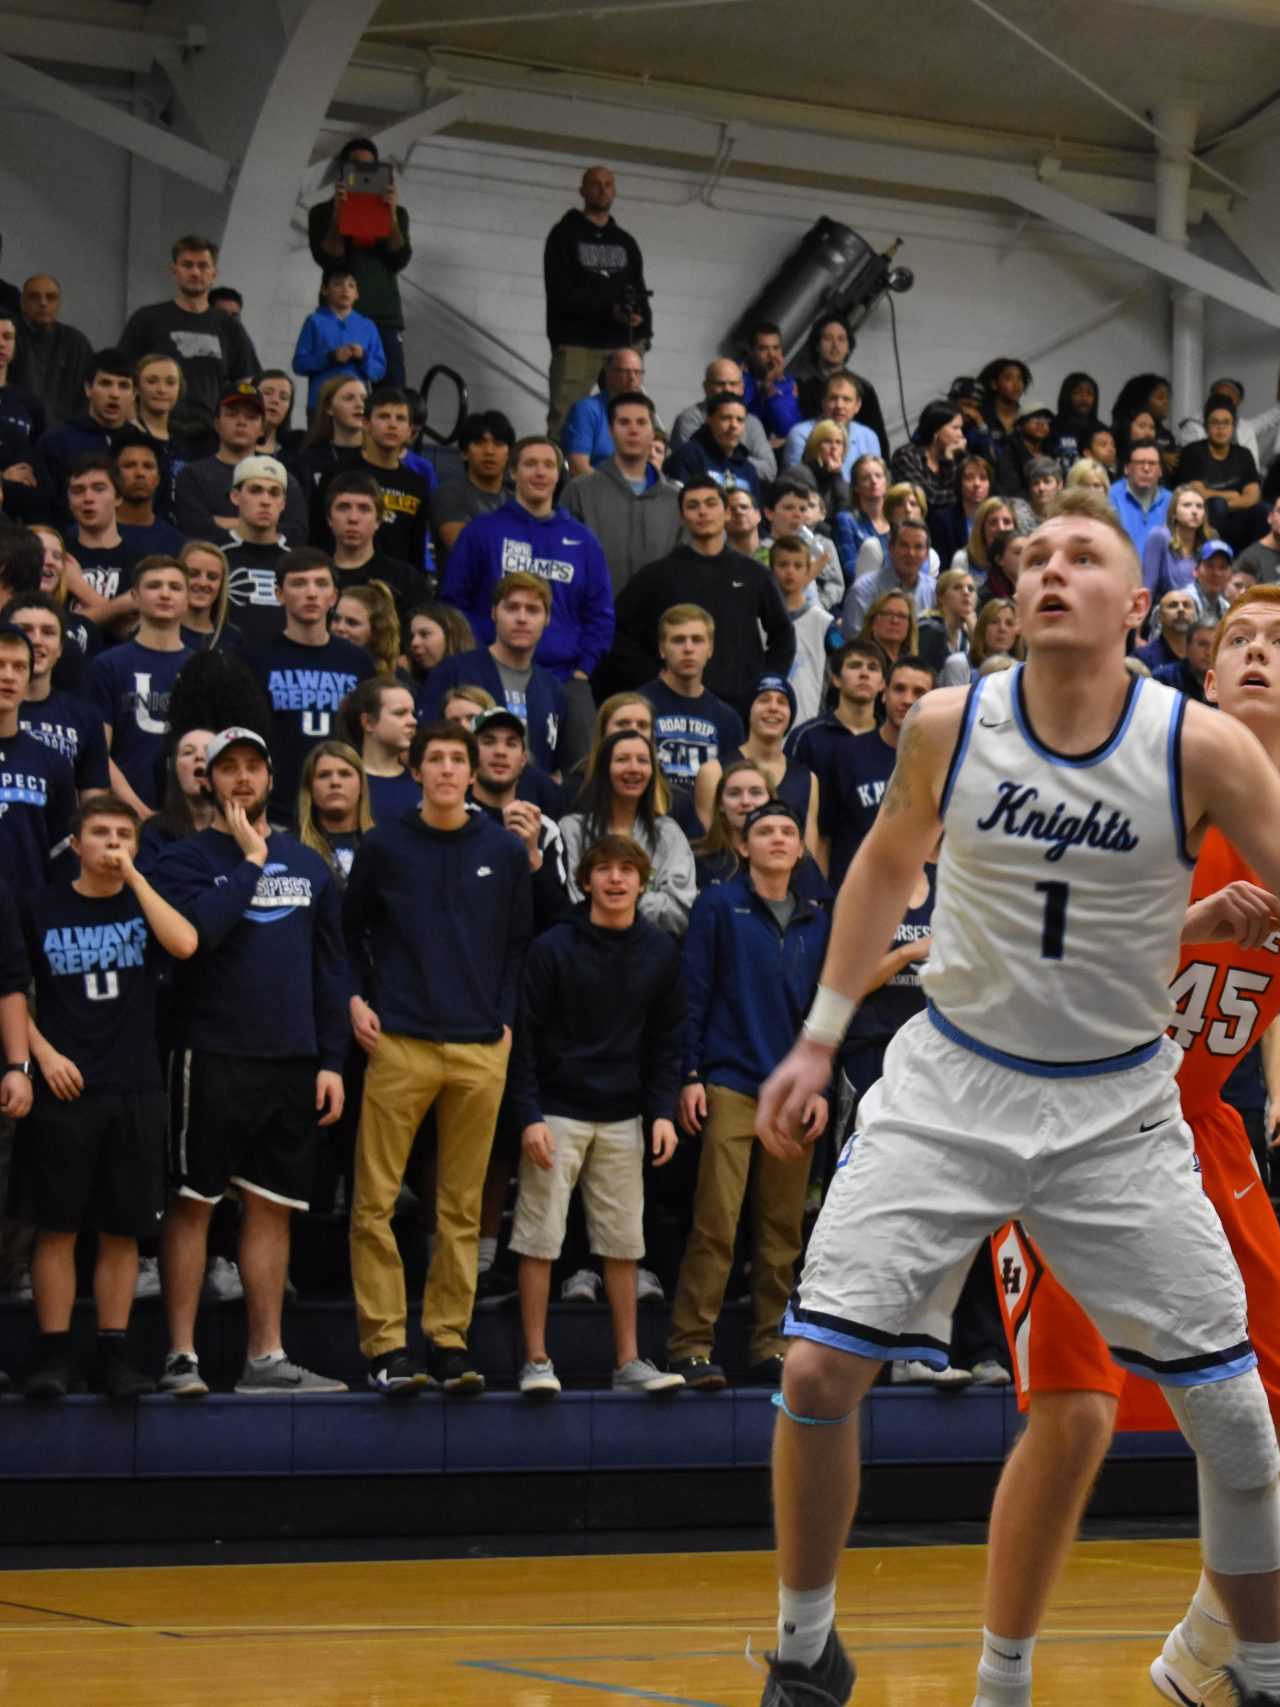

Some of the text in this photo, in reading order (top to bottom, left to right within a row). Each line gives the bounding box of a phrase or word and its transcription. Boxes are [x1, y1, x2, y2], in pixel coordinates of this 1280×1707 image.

[268, 669, 357, 692] ALWAYS
[272, 690, 343, 711] REPPI
[302, 711, 330, 736] U
[659, 717, 716, 737] ROAD TRIP
[977, 780, 1140, 863] Knights
[44, 917, 147, 953] ALWAYS
[1033, 880, 1070, 961] 1
[85, 970, 119, 1000] U
[1166, 959, 1274, 1056] 45
